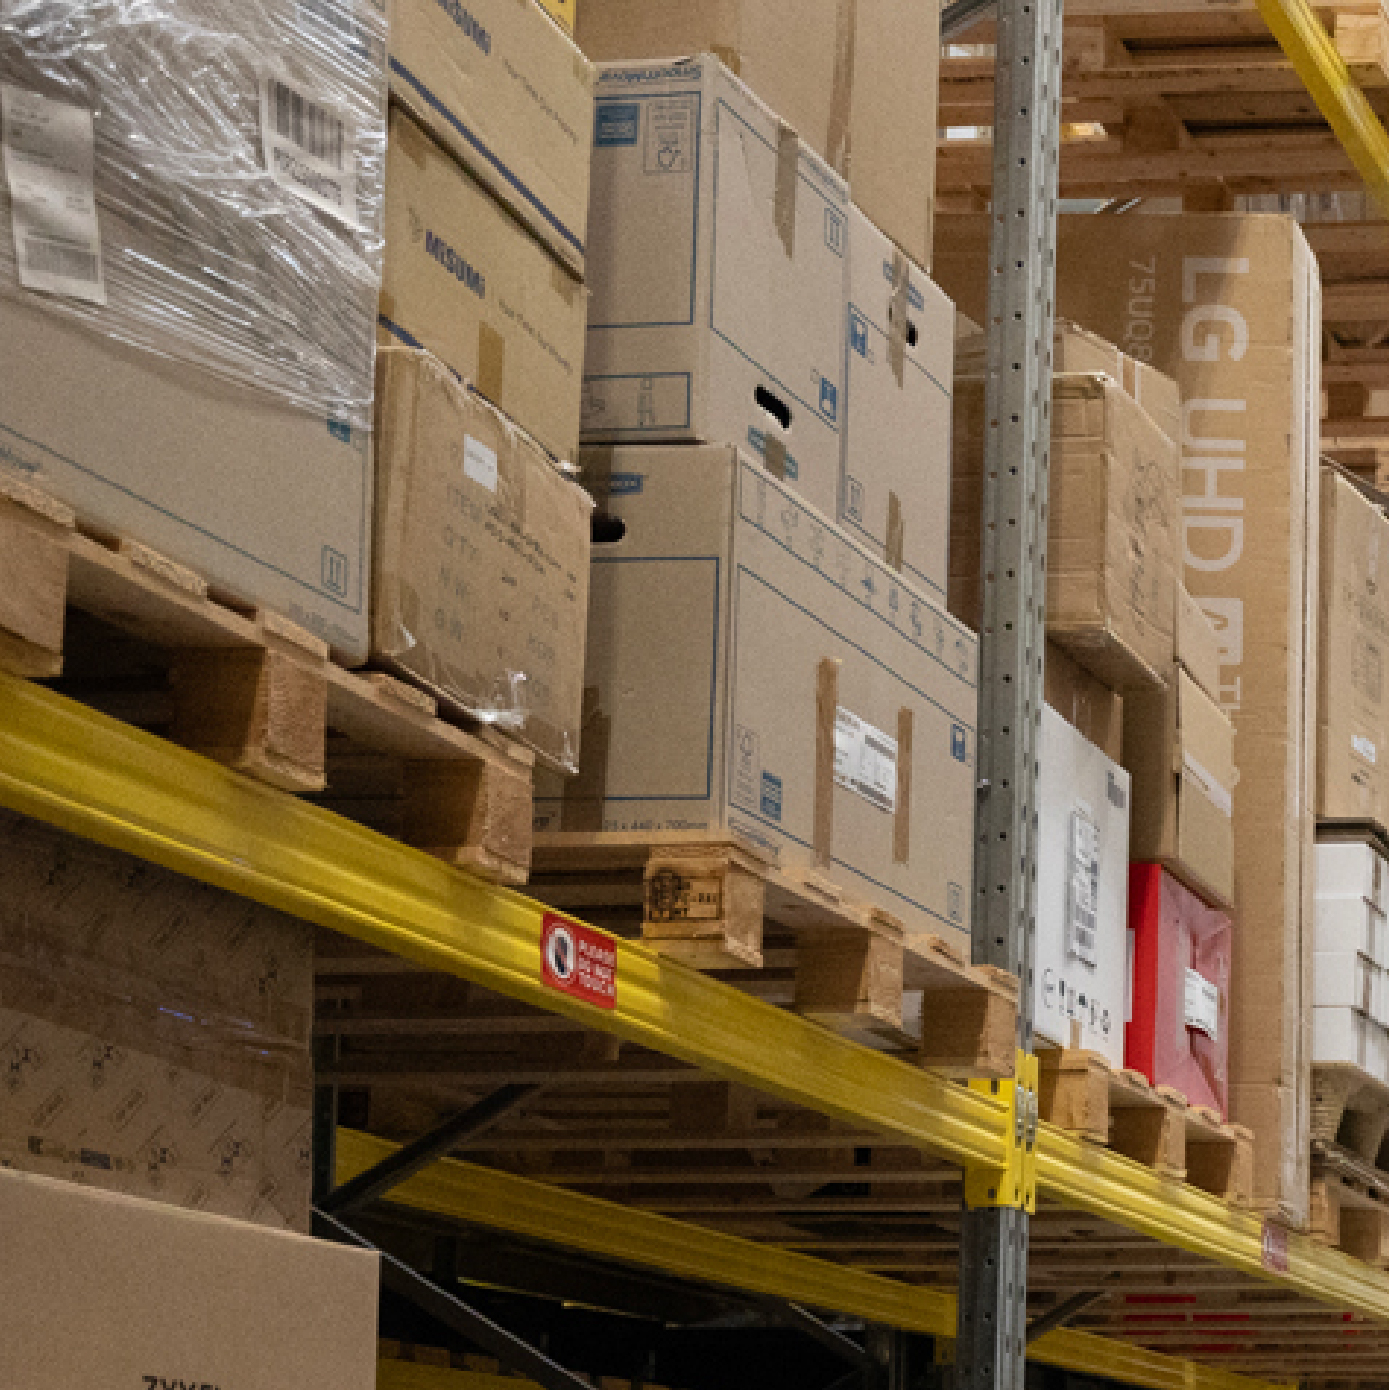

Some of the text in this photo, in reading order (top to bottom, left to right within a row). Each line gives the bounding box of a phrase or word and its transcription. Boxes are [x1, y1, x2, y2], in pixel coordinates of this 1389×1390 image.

[436, 0, 491, 55] ISUMI
[425, 228, 486, 299] MISUMI
[1182, 255, 1250, 362] LG
[1181, 397, 1248, 574] UHD
[578, 939, 615, 965] PLEASE
[594, 961, 614, 982] NOT
[578, 973, 615, 998] TOUCH
